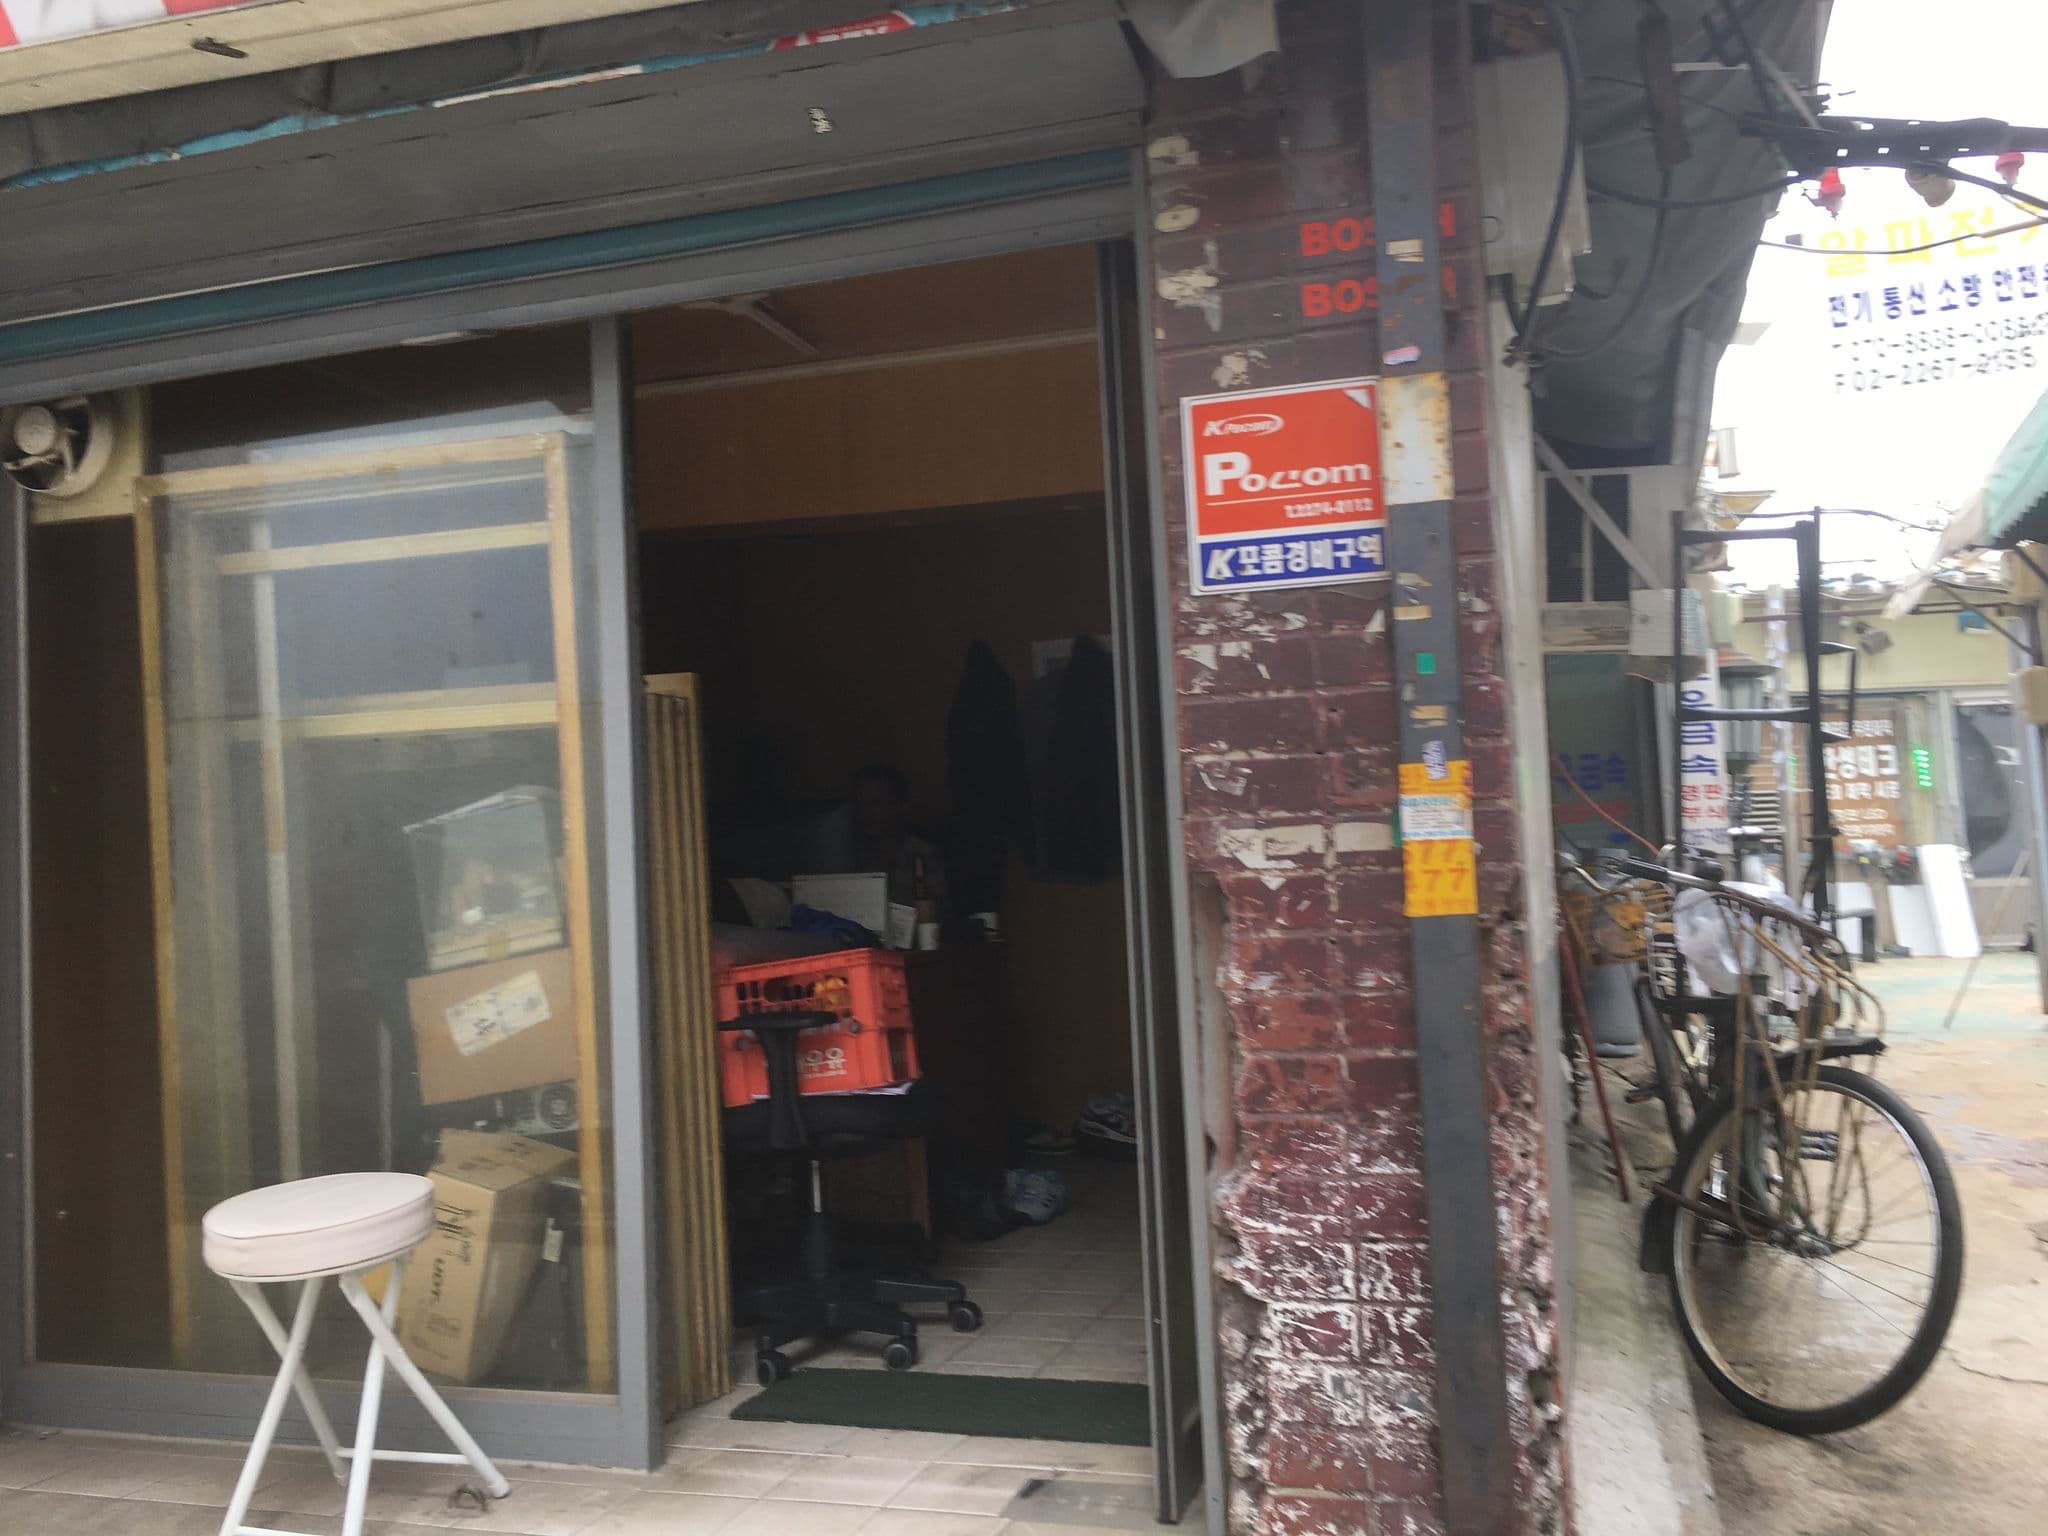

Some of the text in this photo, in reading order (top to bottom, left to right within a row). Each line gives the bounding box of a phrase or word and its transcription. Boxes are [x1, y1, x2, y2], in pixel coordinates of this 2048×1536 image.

[1882, 281, 1928, 320] 통신
[1936, 273, 1983, 313] 소방
[1991, 263, 2048, 302] 안전
